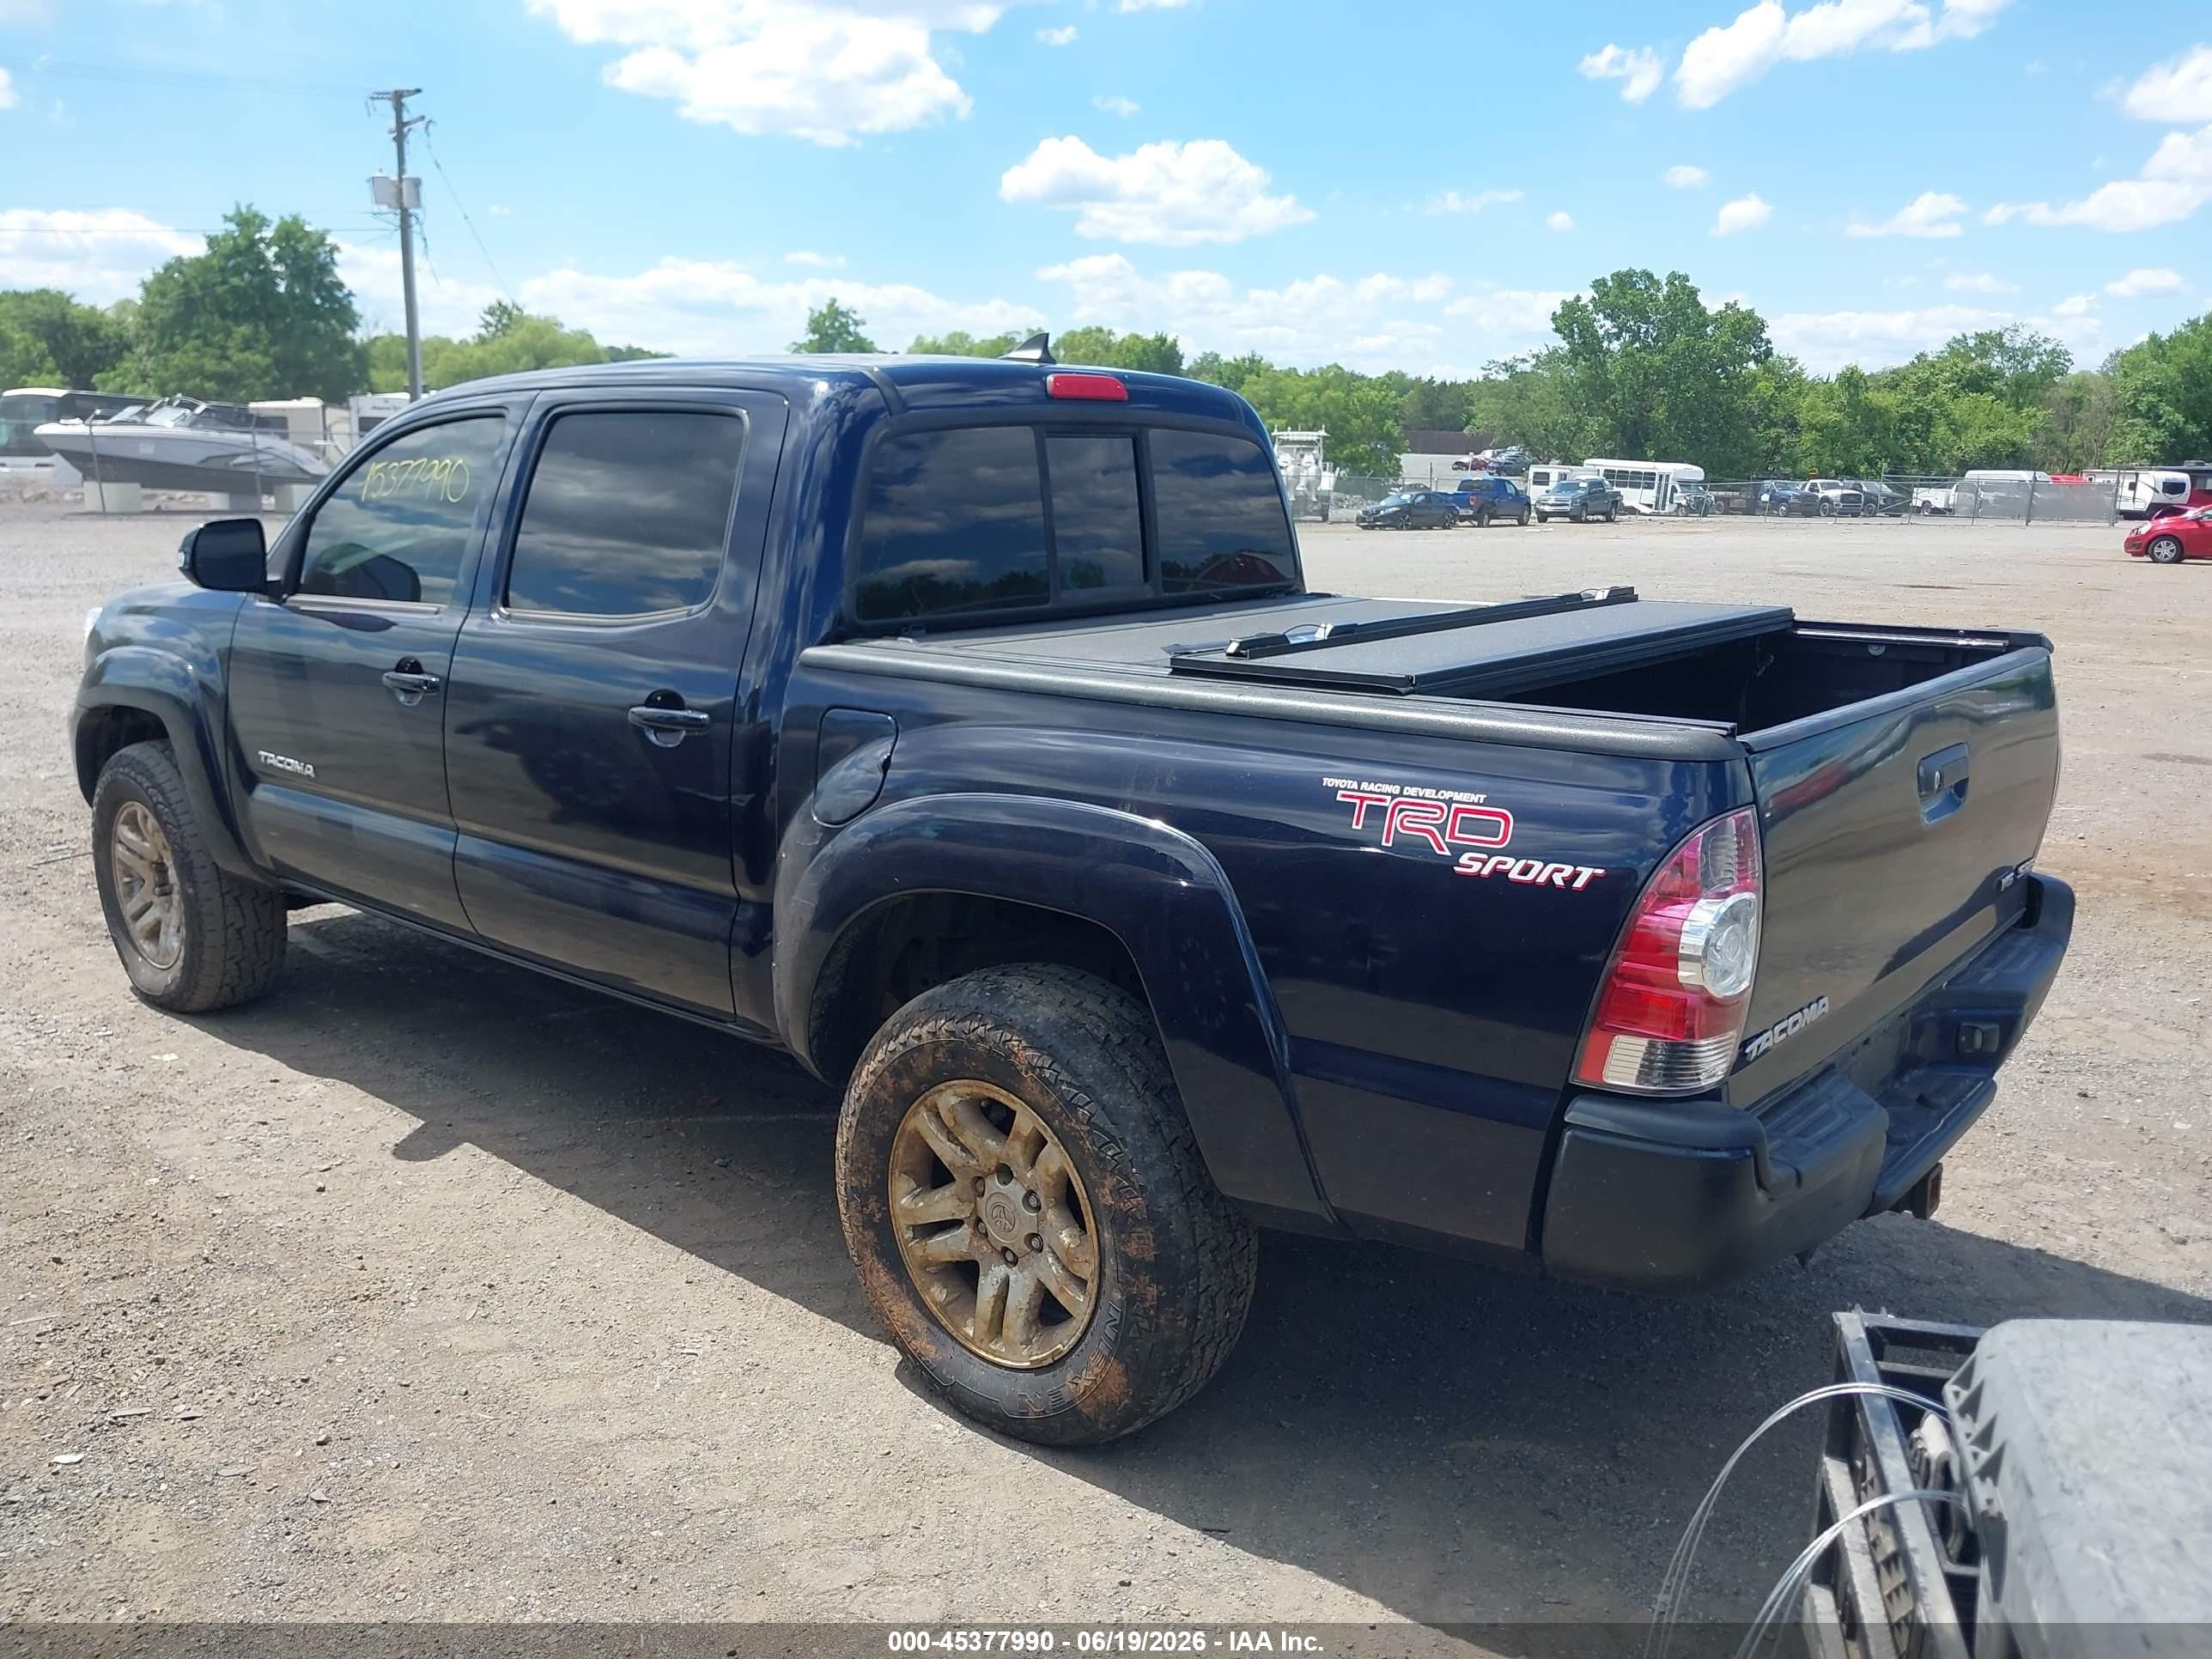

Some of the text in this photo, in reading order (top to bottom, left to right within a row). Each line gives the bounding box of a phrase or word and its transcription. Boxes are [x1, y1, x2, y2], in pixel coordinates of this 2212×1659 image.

[258, 750, 315, 778] TACOMA
[1322, 777, 1487, 804] TOYOTA RACING DEVELOPMENT
[1336, 790, 1514, 856] TRD
[1453, 852, 1607, 891] SPORT
[1744, 996, 1829, 1061] TACOMA
